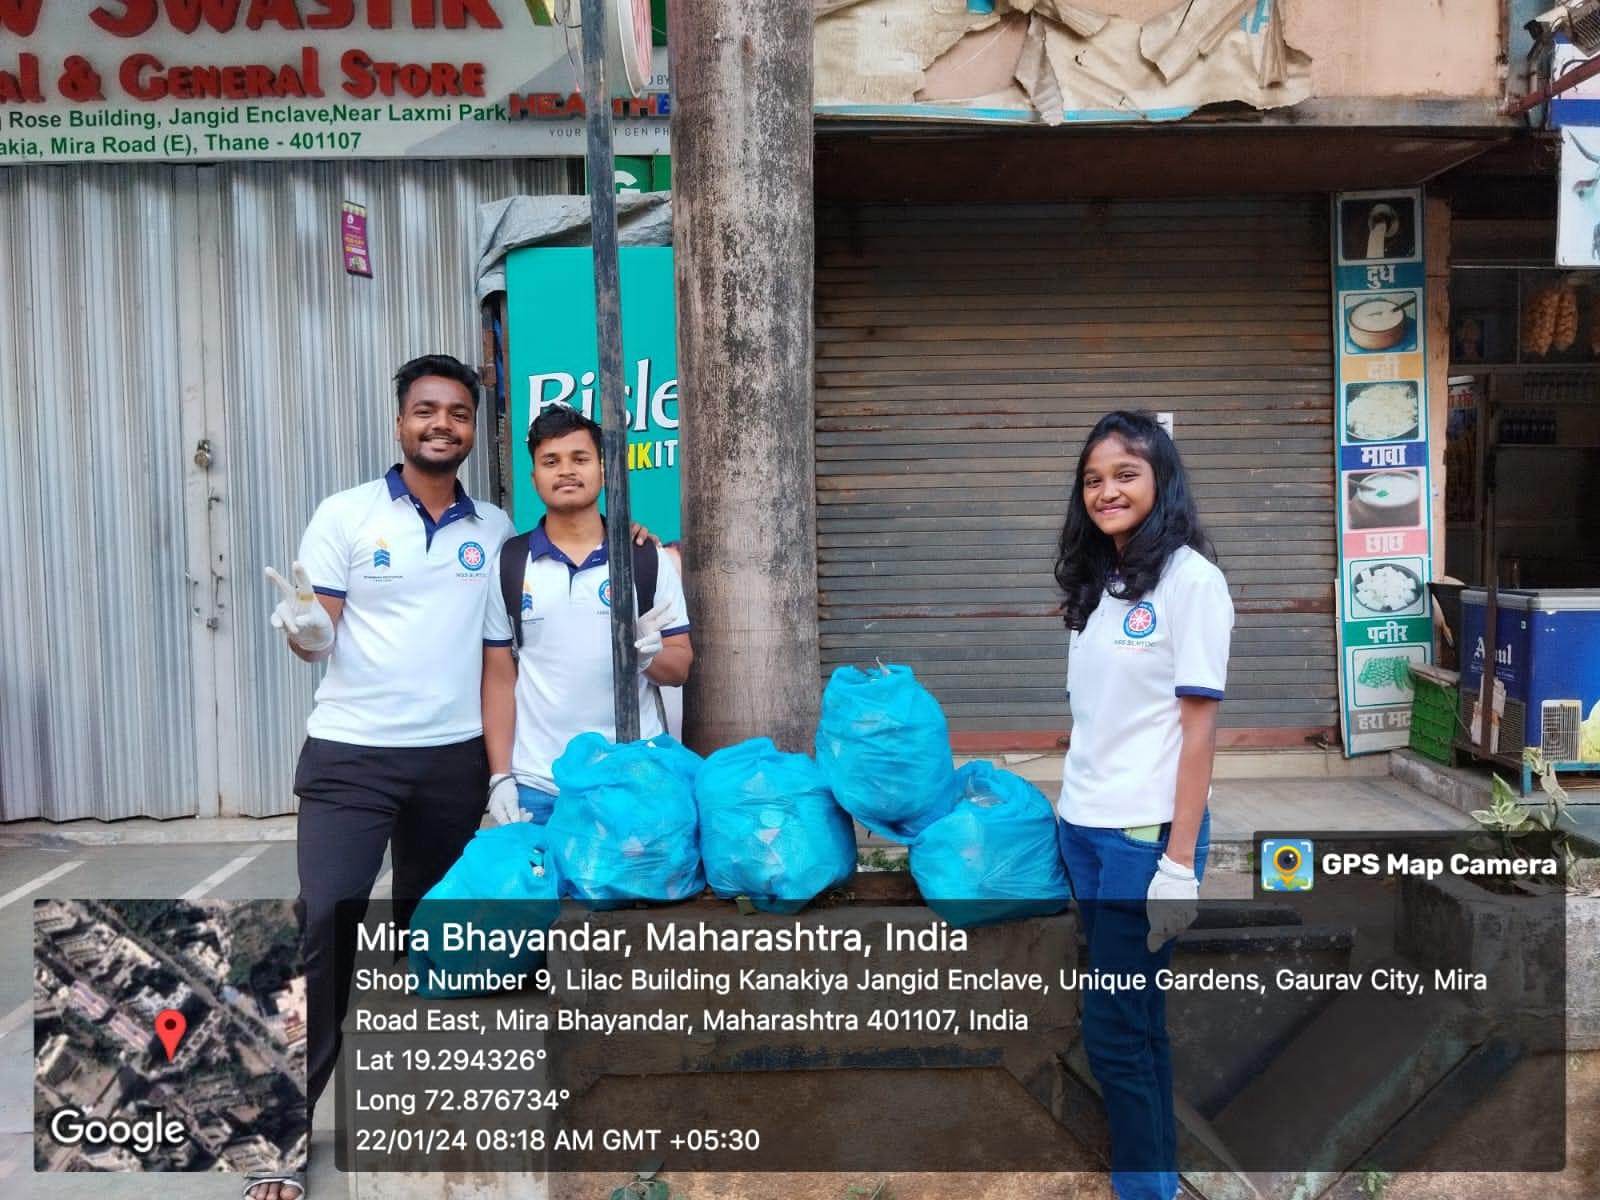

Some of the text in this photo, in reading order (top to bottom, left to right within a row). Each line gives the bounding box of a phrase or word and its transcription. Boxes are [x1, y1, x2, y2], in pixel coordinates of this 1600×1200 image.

[58, 54, 107, 103] &
[340, 49, 487, 98] STORE
[9, 111, 62, 128] Rose
[69, 109, 162, 130] Building,
[169, 107, 239, 127] Jangid
[389, 104, 451, 121] Laxmi
[459, 103, 512, 123] Park,
[51, 137, 95, 154] Mira
[102, 136, 156, 153] Road
[204, 133, 270, 150] Thane
[289, 132, 361, 150] 401107
[1367, 620, 1409, 644] पनीर
[1473, 636, 1512, 665] Aul
